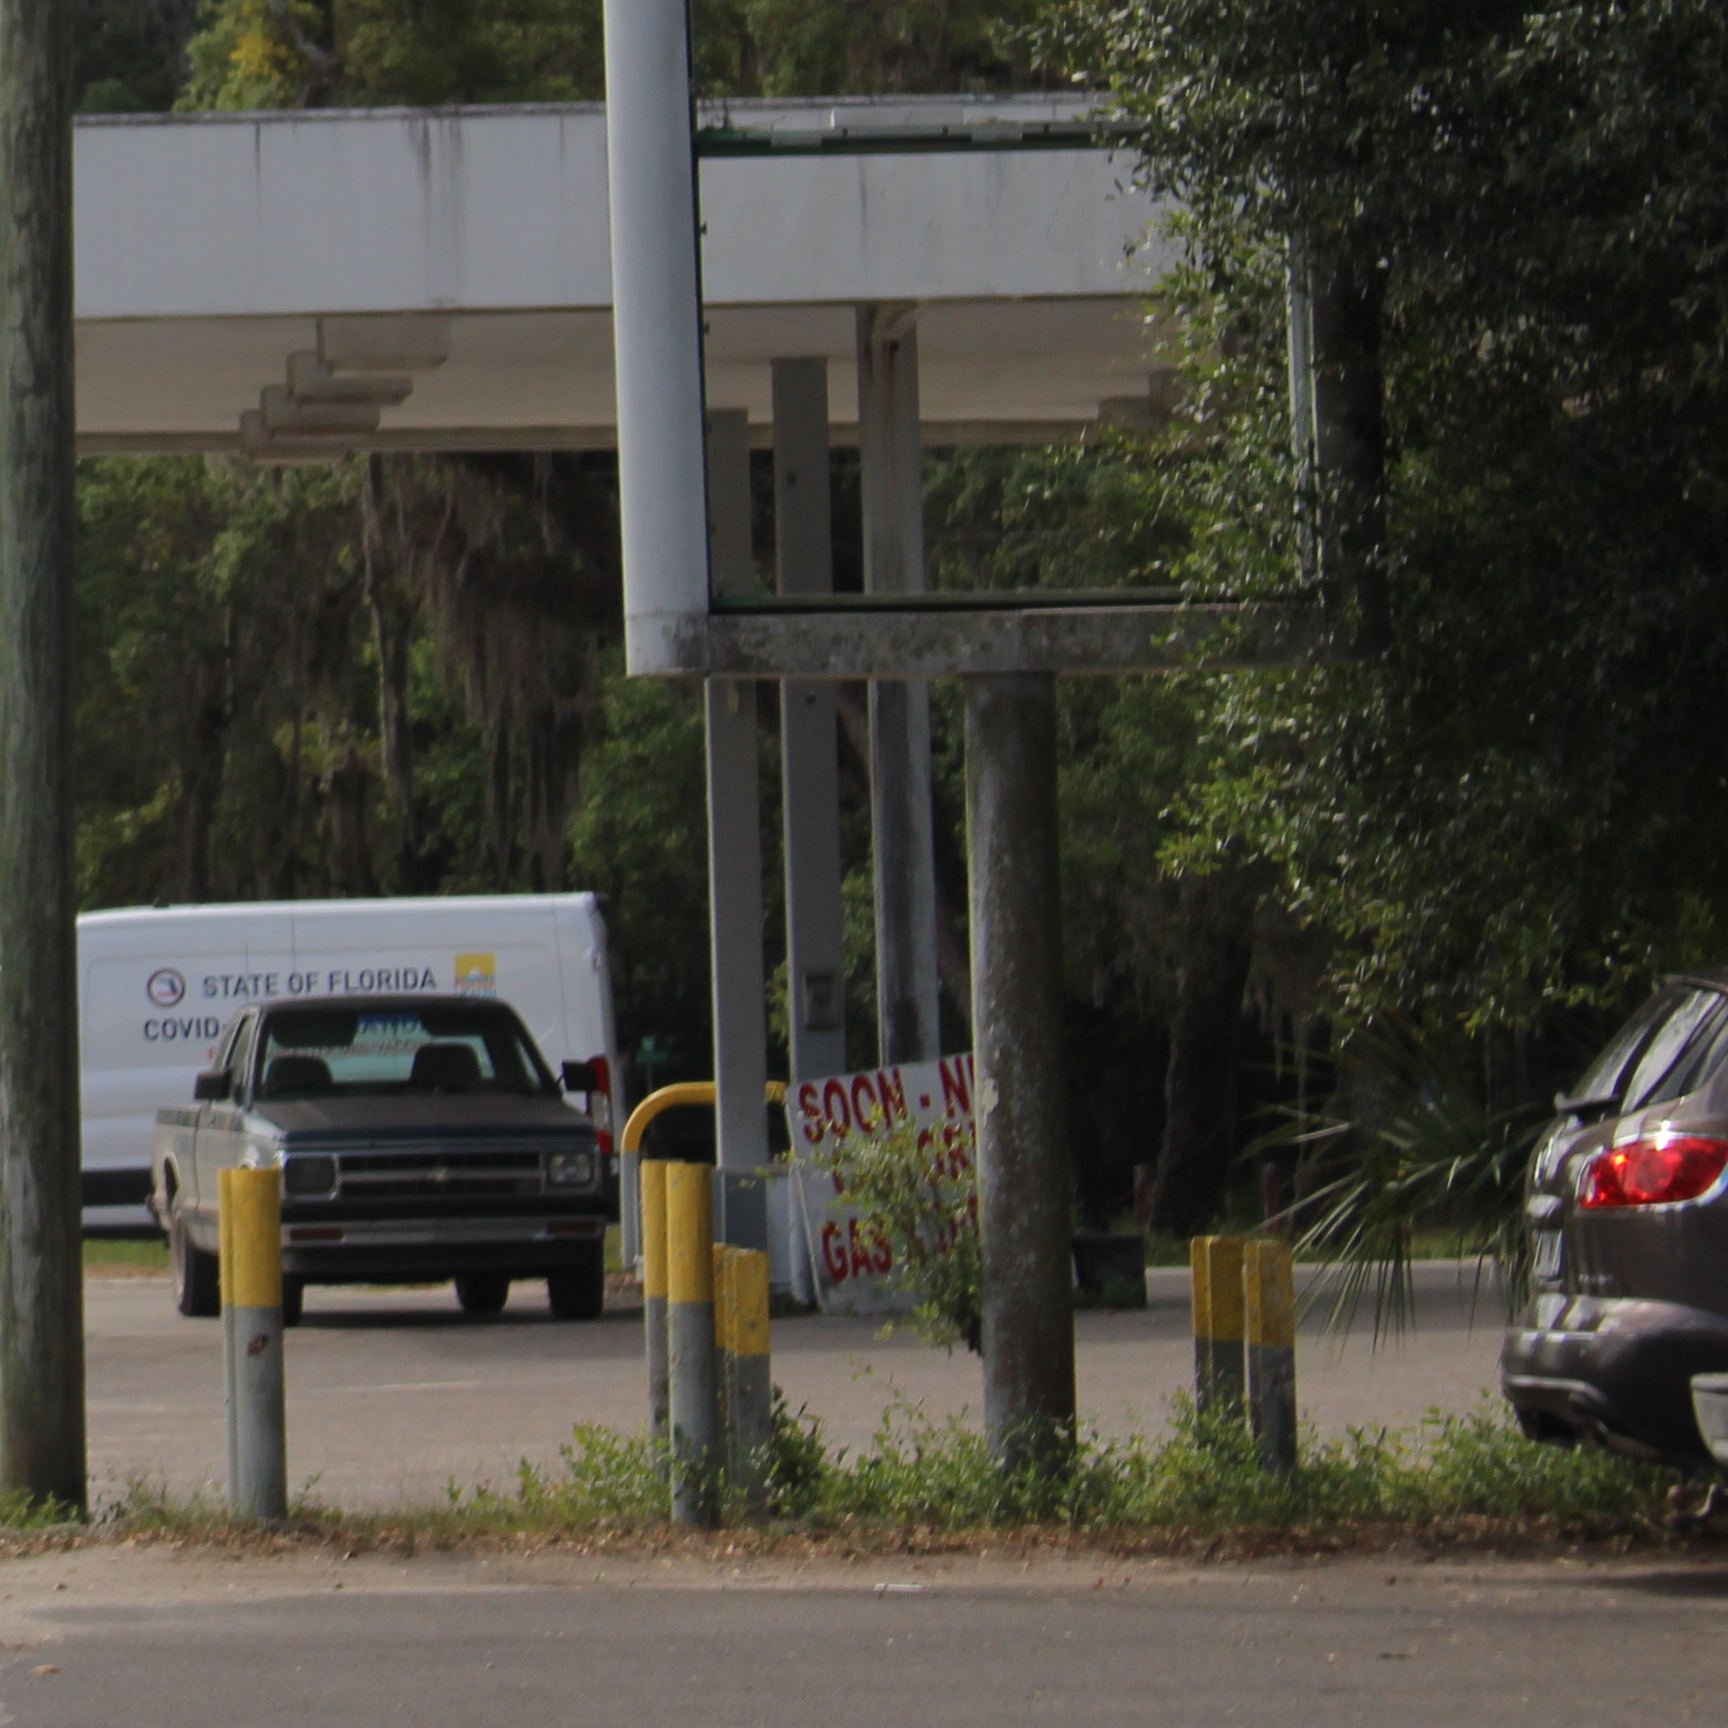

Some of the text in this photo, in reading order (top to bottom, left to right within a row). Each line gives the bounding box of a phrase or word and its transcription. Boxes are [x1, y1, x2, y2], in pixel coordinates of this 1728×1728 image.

[204, 967, 437, 999] STATE OF FLORIDA
[799, 1066, 909, 1145] SOON
[822, 1217, 893, 1282] GAS
